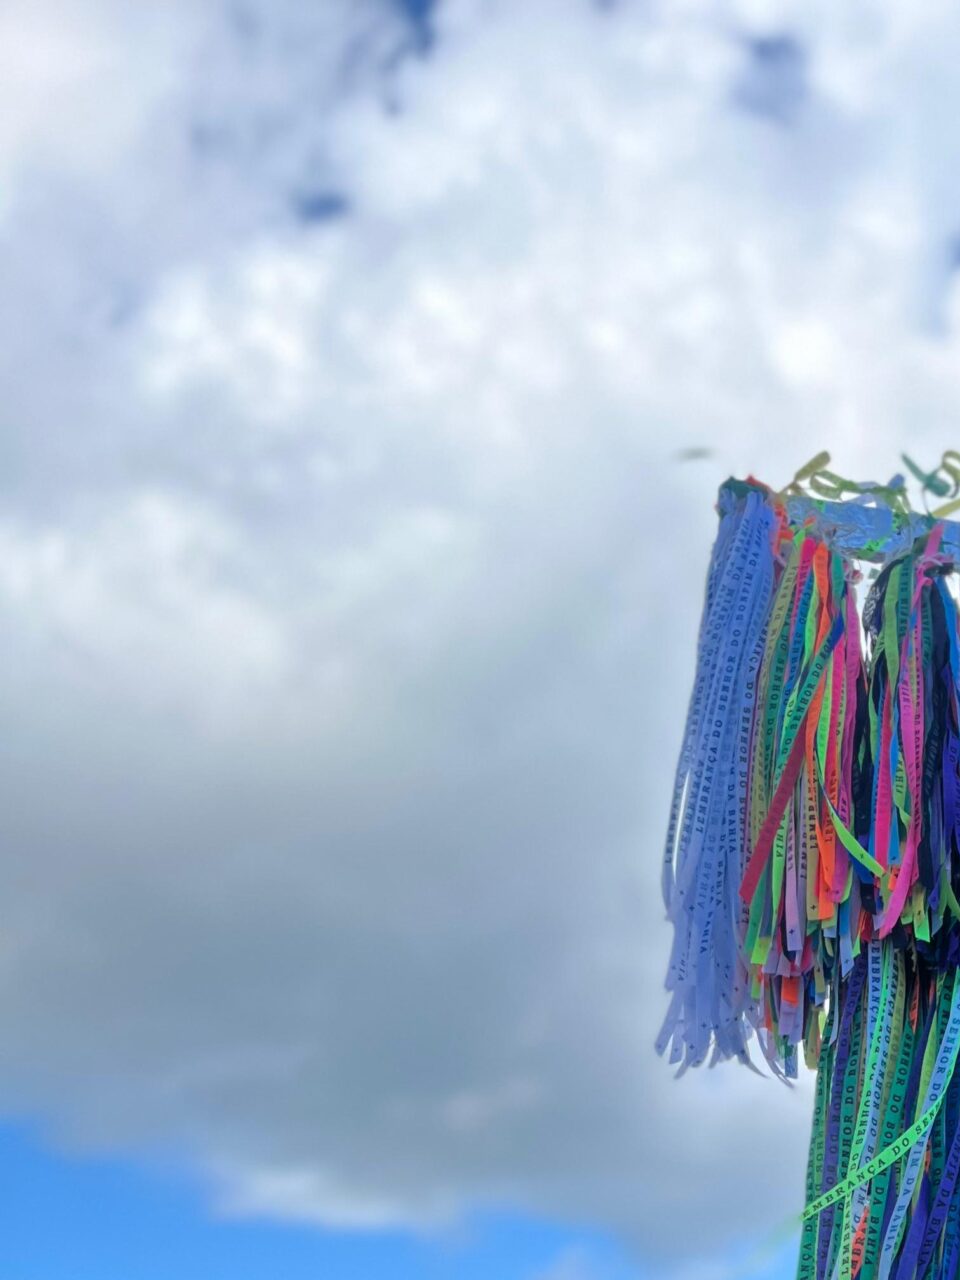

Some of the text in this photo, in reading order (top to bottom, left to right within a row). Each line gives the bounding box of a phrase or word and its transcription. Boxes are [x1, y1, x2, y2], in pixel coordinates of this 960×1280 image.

[712, 720, 723, 739] DO
[730, 629, 741, 648] DO
[745, 680, 754, 700] DO
[937, 1018, 960, 1075] SENHOR
[929, 1083, 942, 1101] DO
[893, 1137, 910, 1154] DO
[903, 1178, 915, 1195] DA
[874, 1188, 885, 1206] DA
[884, 1205, 906, 1251] BAHIA
[865, 1217, 879, 1266] BAHIA
